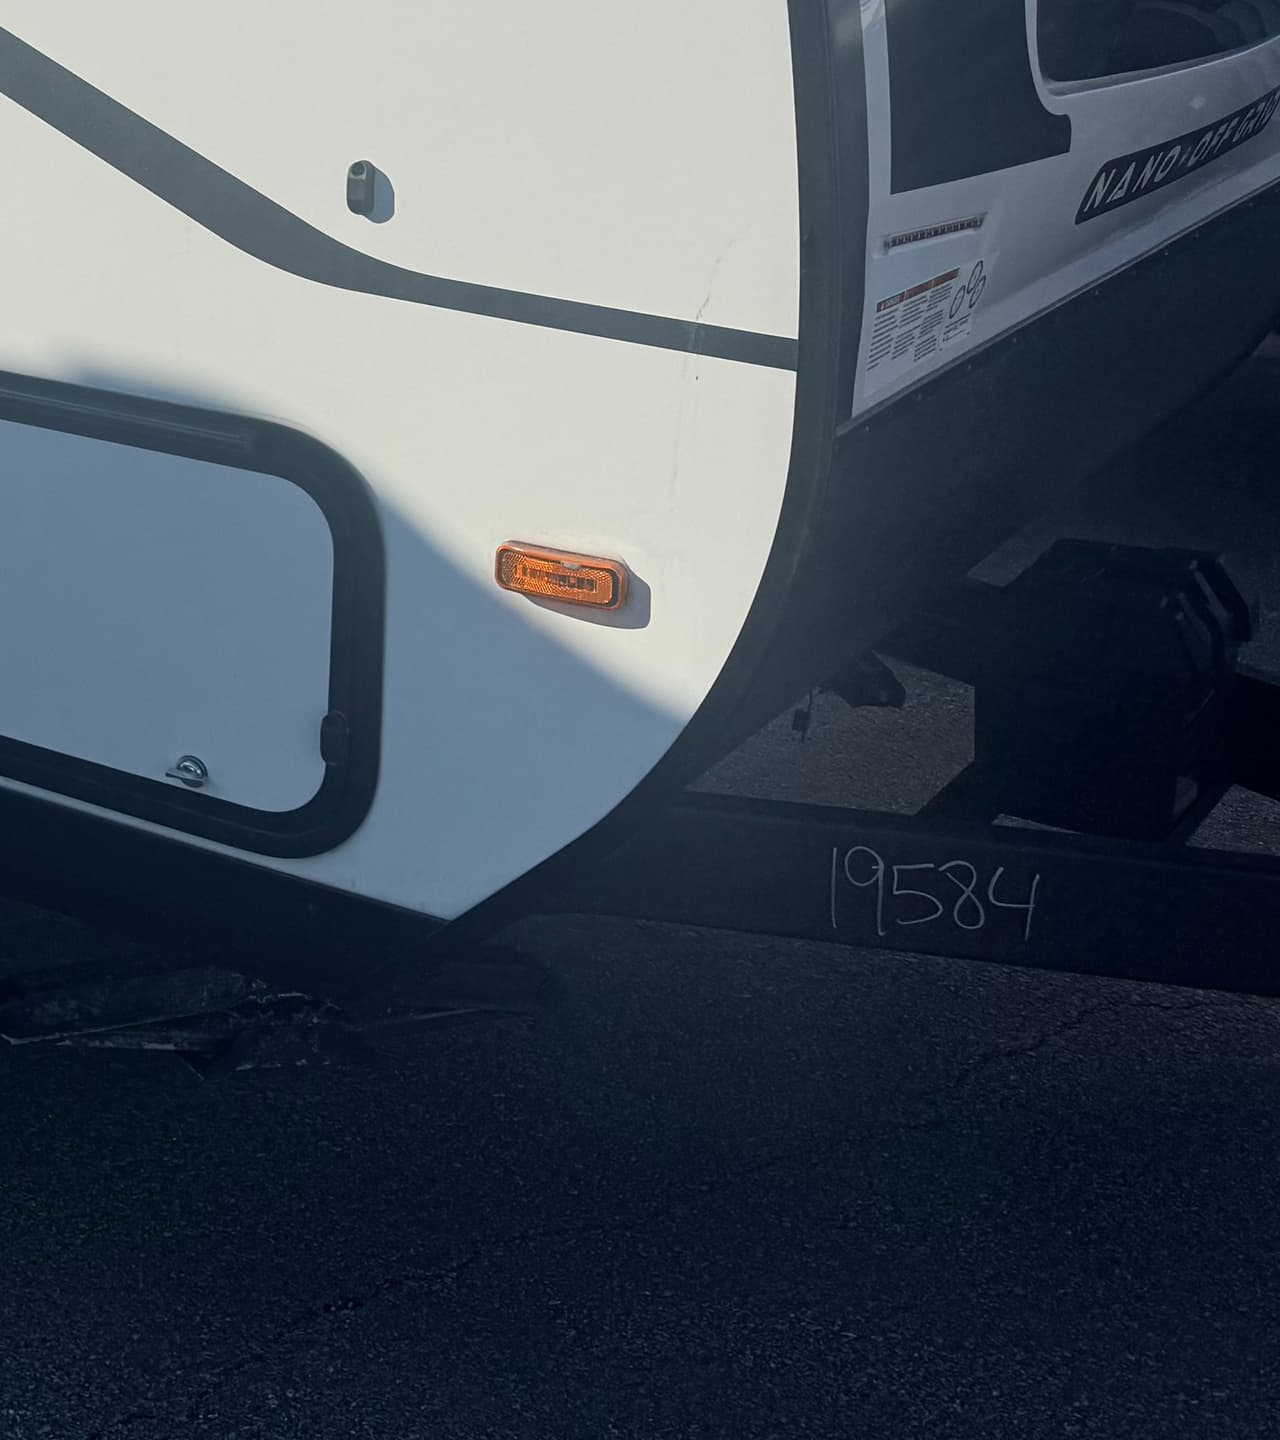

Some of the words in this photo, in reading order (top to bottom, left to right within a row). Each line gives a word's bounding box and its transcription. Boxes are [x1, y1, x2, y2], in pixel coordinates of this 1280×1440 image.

[1083, 146, 1182, 213] NANO
[1188, 117, 1239, 168] OFF
[831, 846, 1040, 941] 19584
